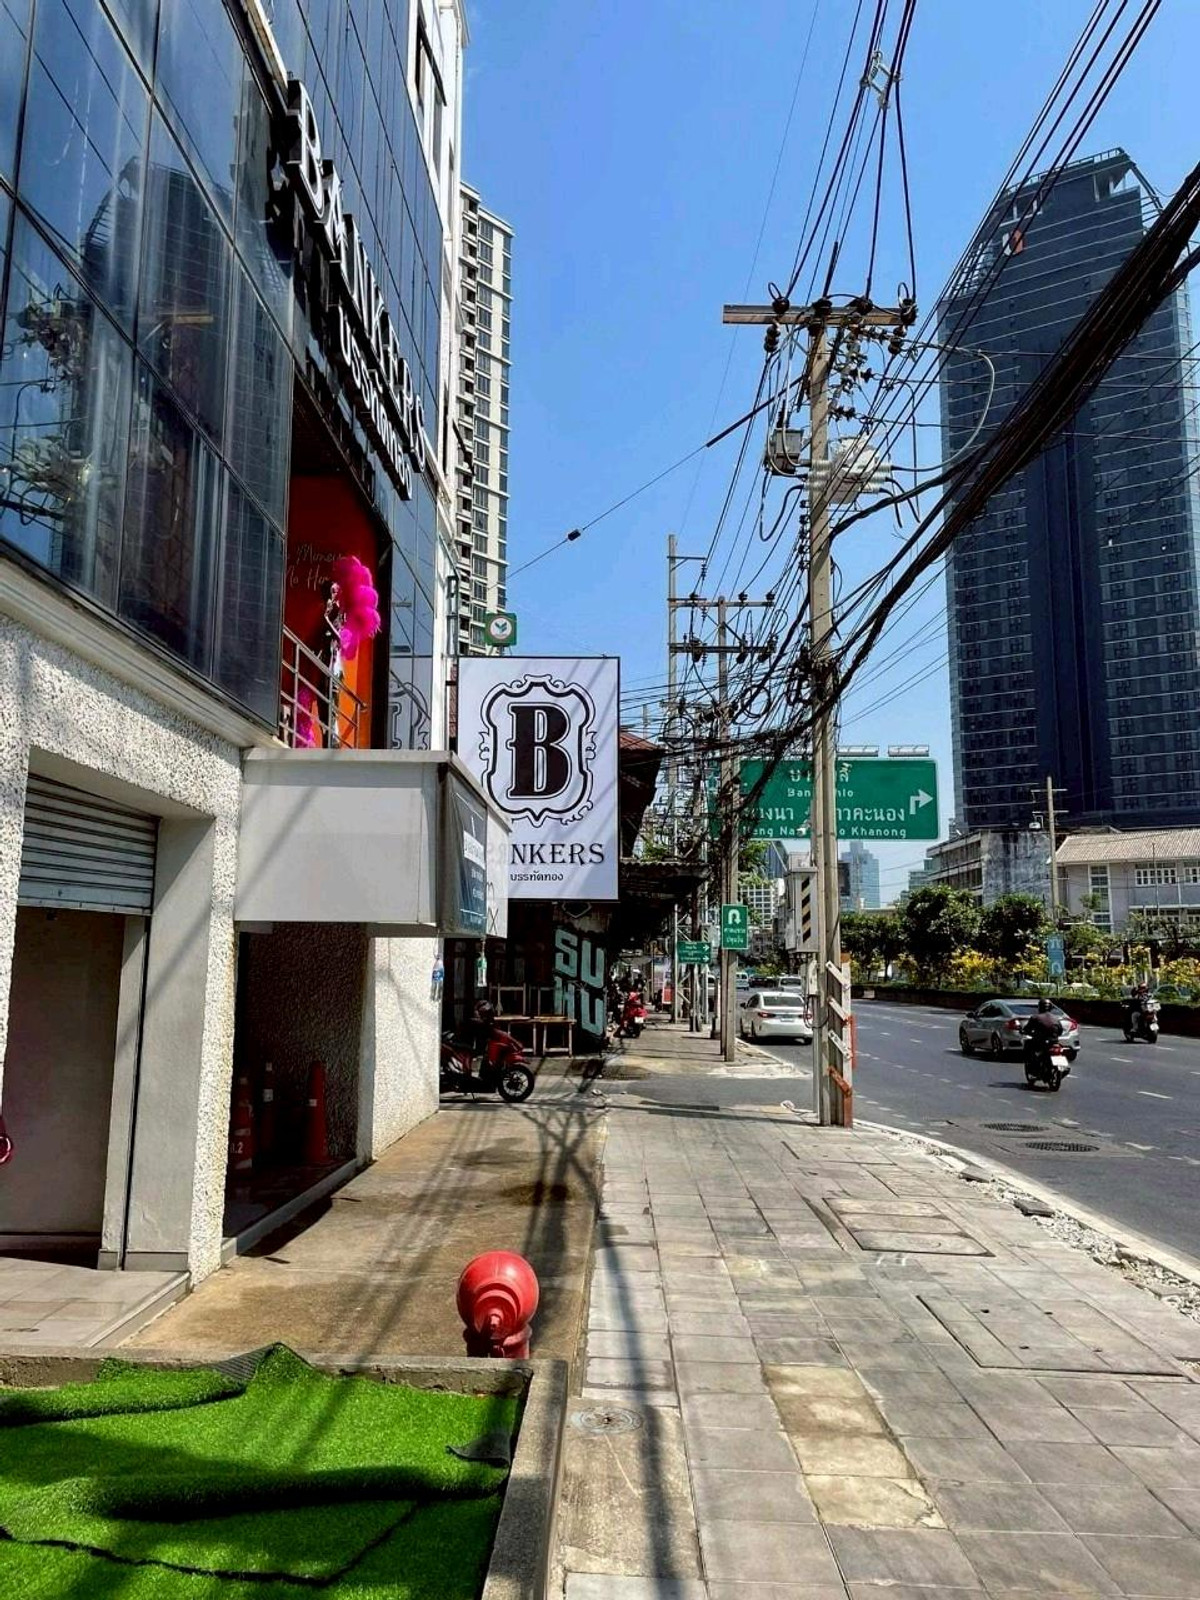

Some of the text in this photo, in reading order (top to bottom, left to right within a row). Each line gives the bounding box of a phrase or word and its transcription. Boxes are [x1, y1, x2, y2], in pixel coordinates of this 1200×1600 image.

[505, 701, 572, 800] B
[836, 807, 905, 822] าวคะนอง
[851, 826, 907, 839] Khanong
[510, 871, 564, 882] บรรทัดทอง
